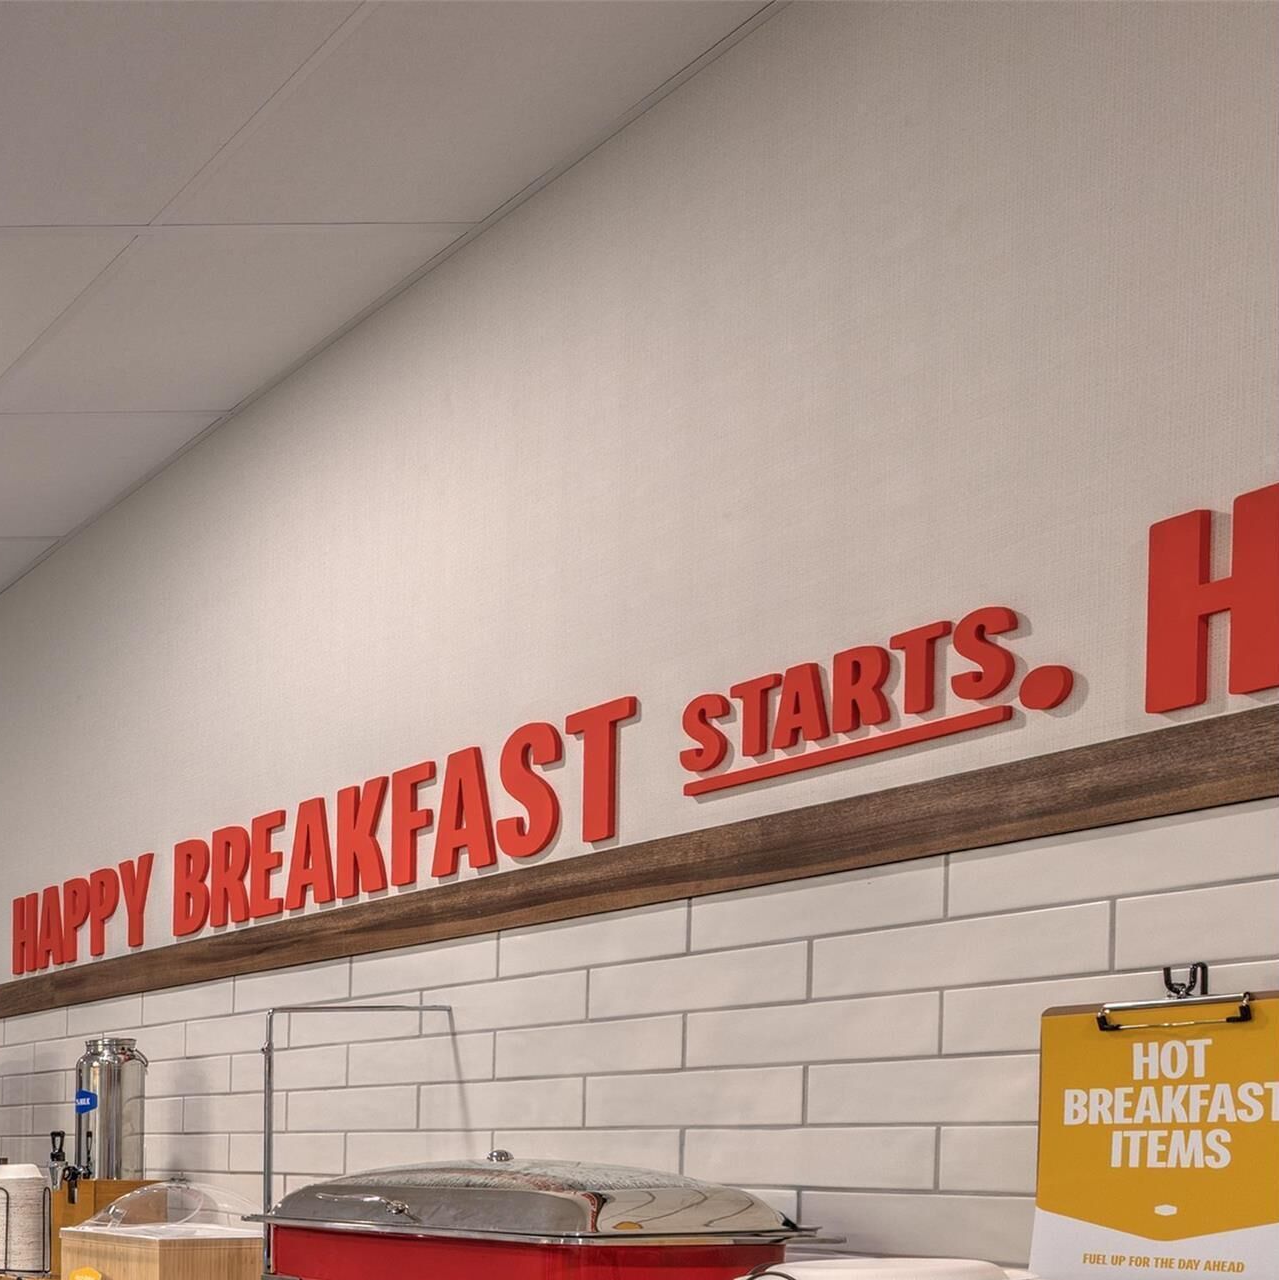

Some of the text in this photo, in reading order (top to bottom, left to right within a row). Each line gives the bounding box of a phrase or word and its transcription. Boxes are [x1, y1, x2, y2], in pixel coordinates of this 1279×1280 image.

[12, 482, 1279, 975] HAPPY BREAKFAST STARTS. H
[1132, 1038, 1213, 1081] HOT
[1064, 1082, 1279, 1125] BREAKFAST
[1110, 1128, 1232, 1169] ITEMS
[1082, 1253, 1245, 1273] FUEL UP FOR THE DAY AHEAD
